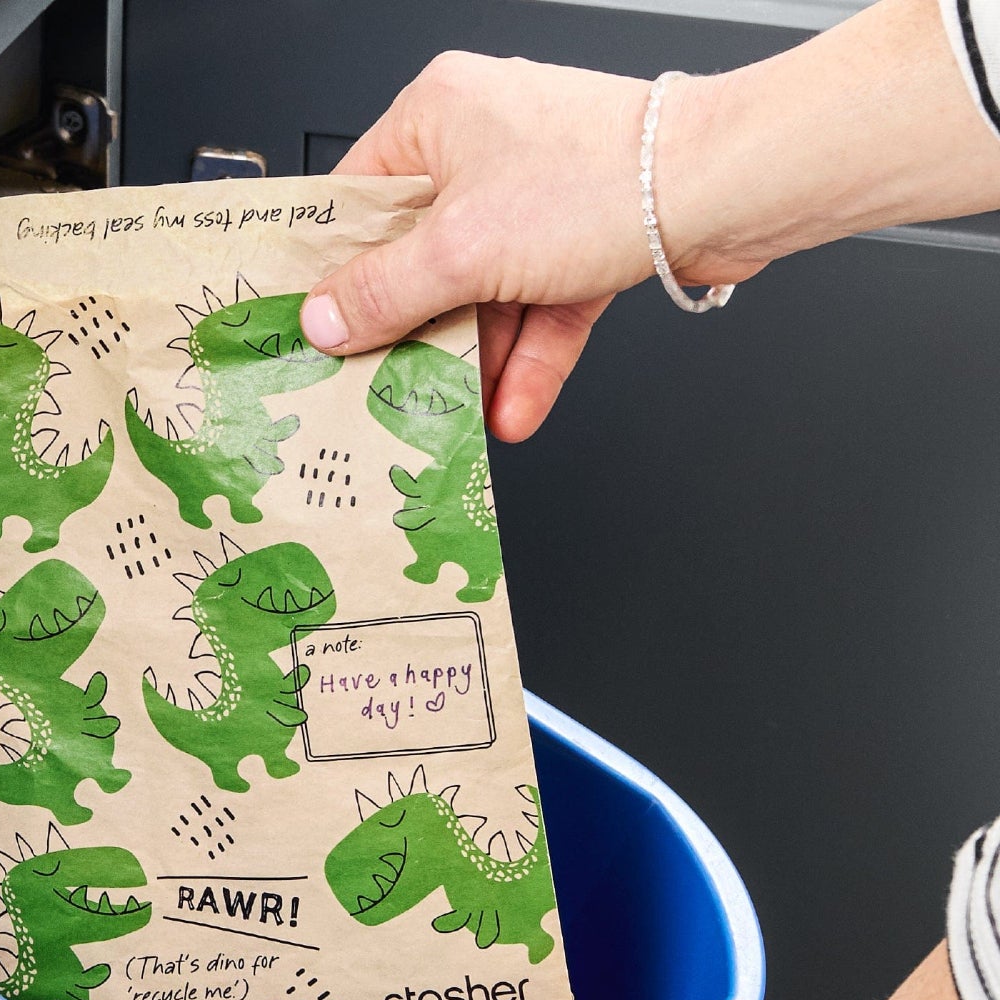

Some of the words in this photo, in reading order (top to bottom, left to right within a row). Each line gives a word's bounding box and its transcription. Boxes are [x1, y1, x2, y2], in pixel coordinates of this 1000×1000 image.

[153, 205, 186, 230] my
[193, 208, 233, 233] toss
[238, 208, 282, 230] and
[288, 199, 336, 228] Peel
[16, 217, 96, 244] backing
[103, 215, 144, 240] seal
[305, 644, 316, 657] a
[322, 633, 363, 655] note:
[319, 673, 381, 694] Have
[388, 672, 398, 688] a
[405, 663, 472, 696] happy
[177, 885, 301, 930] RAWR!
[125, 953, 201, 981] (That's
[206, 952, 246, 972] dino
[251, 954, 280, 976] for
